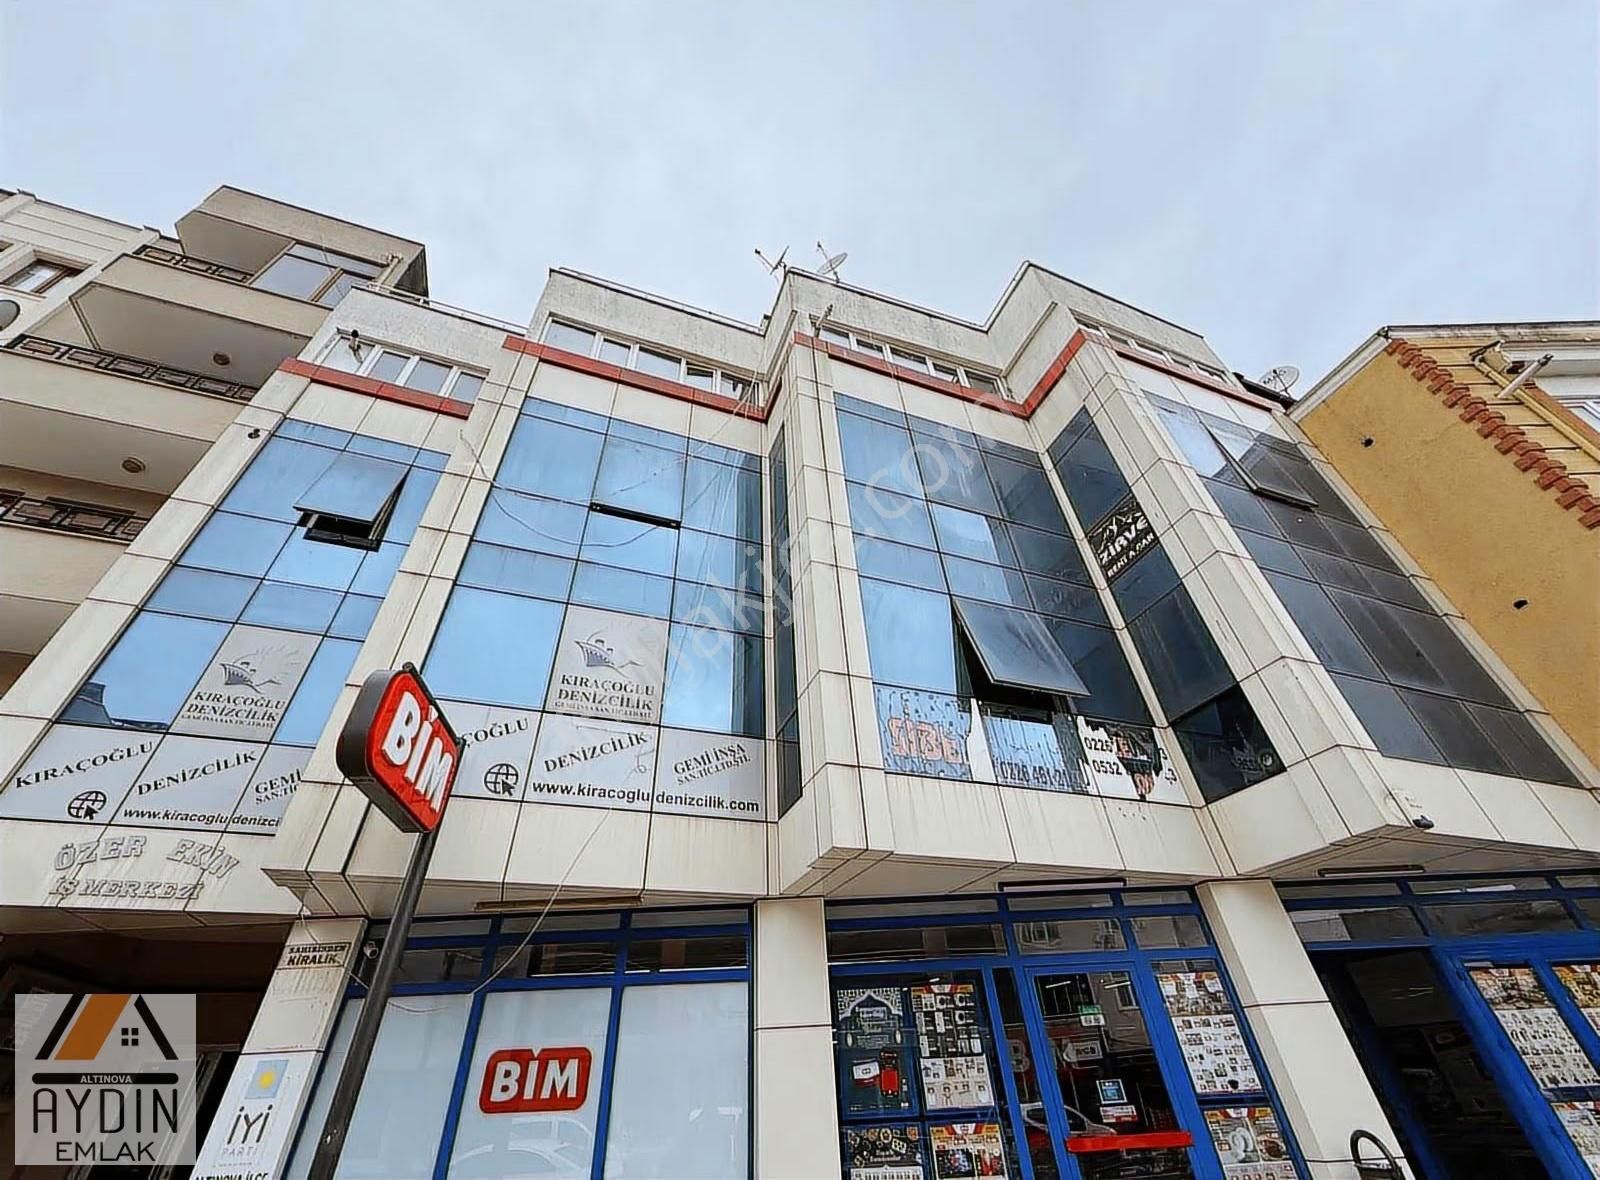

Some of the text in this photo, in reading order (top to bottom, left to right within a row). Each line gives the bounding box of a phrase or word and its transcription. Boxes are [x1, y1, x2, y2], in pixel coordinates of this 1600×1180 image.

[561, 674, 655, 696] KIRAÇOĞLU
[195, 691, 286, 709] KIRAÇOĞLU
[558, 688, 654, 711] DENİZCİLİK
[187, 703, 279, 721] DENİZCİLİK
[463, 718, 529, 749] ÇOĞLU
[543, 731, 648, 773] DENİZCİLİK
[16, 741, 153, 788] KIRAÇOĞLU
[137, 751, 257, 795] DENİZCİLİK
[1092, 759, 1122, 775] 0532
[55, 836, 240, 879] ÖZER EKİN
[78, 878, 205, 900] MERKEZİ
